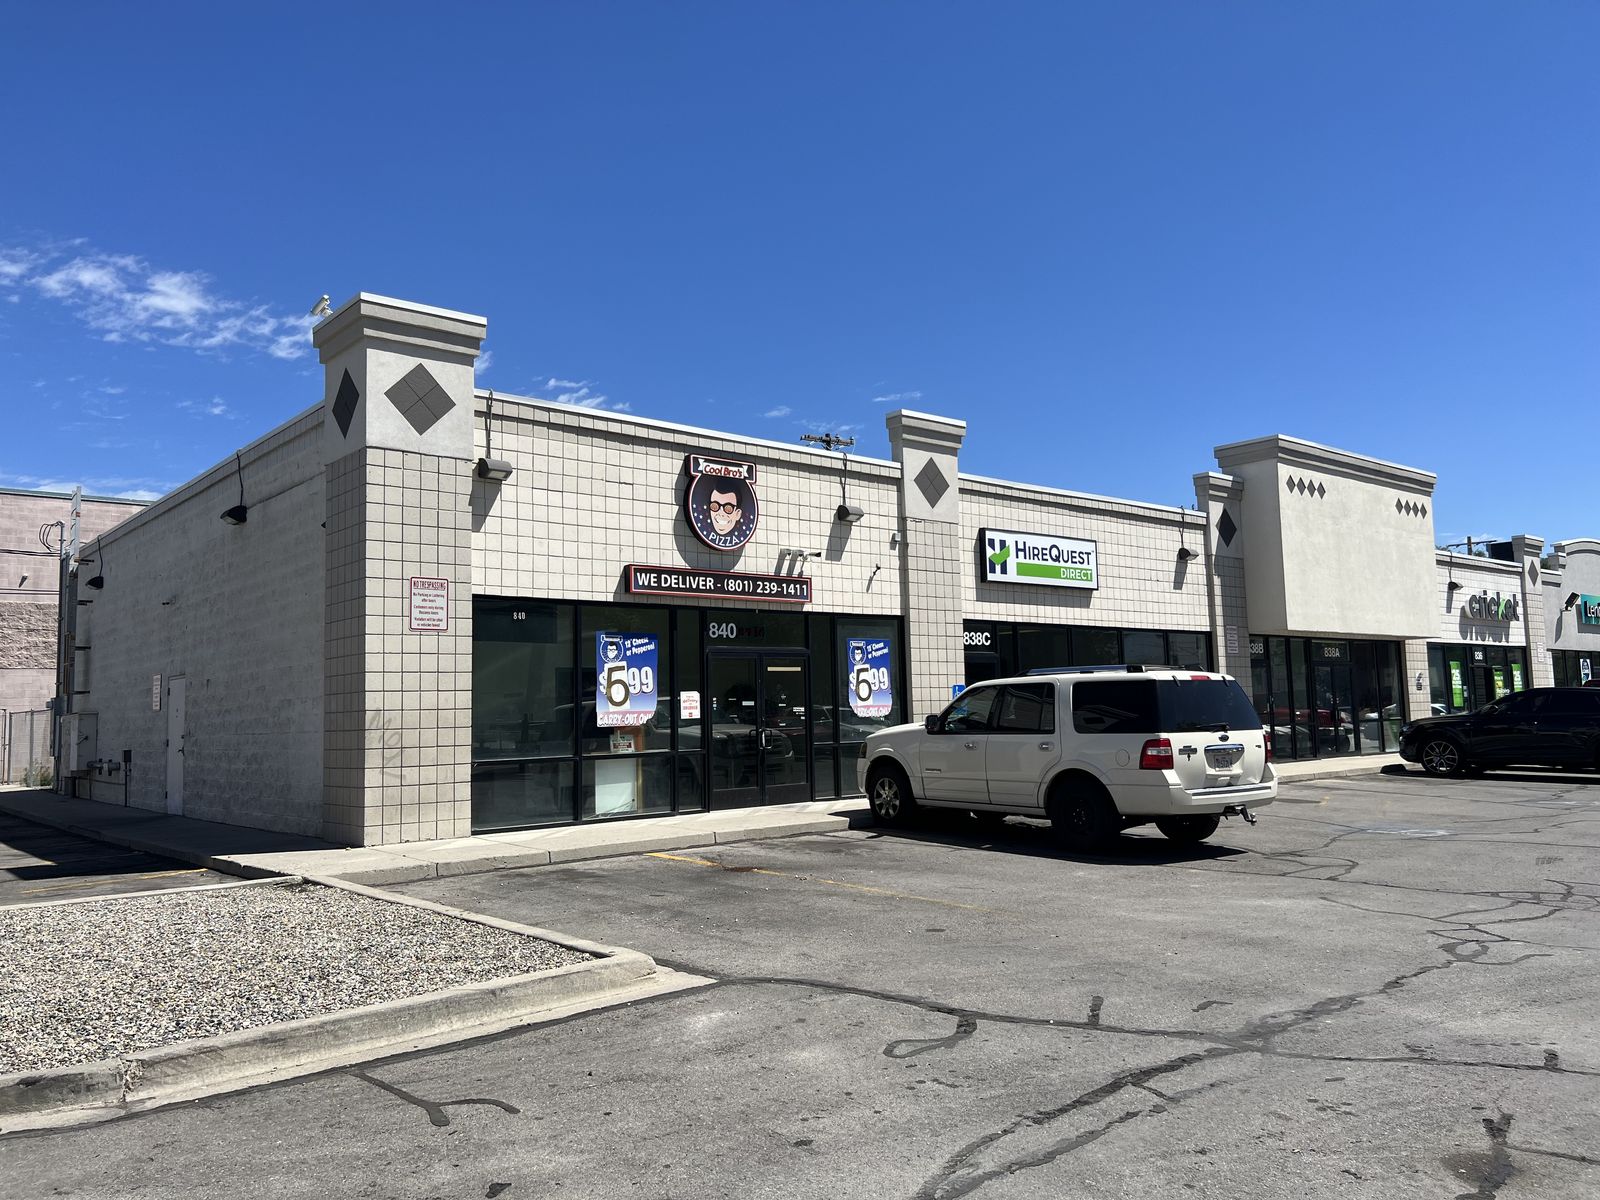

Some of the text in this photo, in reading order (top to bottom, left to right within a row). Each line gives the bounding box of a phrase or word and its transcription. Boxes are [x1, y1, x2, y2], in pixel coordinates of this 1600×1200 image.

[704, 464, 743, 478] Cool Bro's
[708, 532, 740, 546] PIZZA
[1060, 567, 1092, 580] DIRECT
[636, 572, 658, 587] WE
[661, 573, 714, 590] DELIVER
[724, 578, 753, 593] (801)
[756, 581, 807, 596] 239-1411
[1465, 589, 1519, 622] cricket
[1584, 600, 1600, 618] Len
[709, 622, 737, 639] 840
[963, 631, 991, 646] 838C
[1249, 643, 1264, 654] 38B
